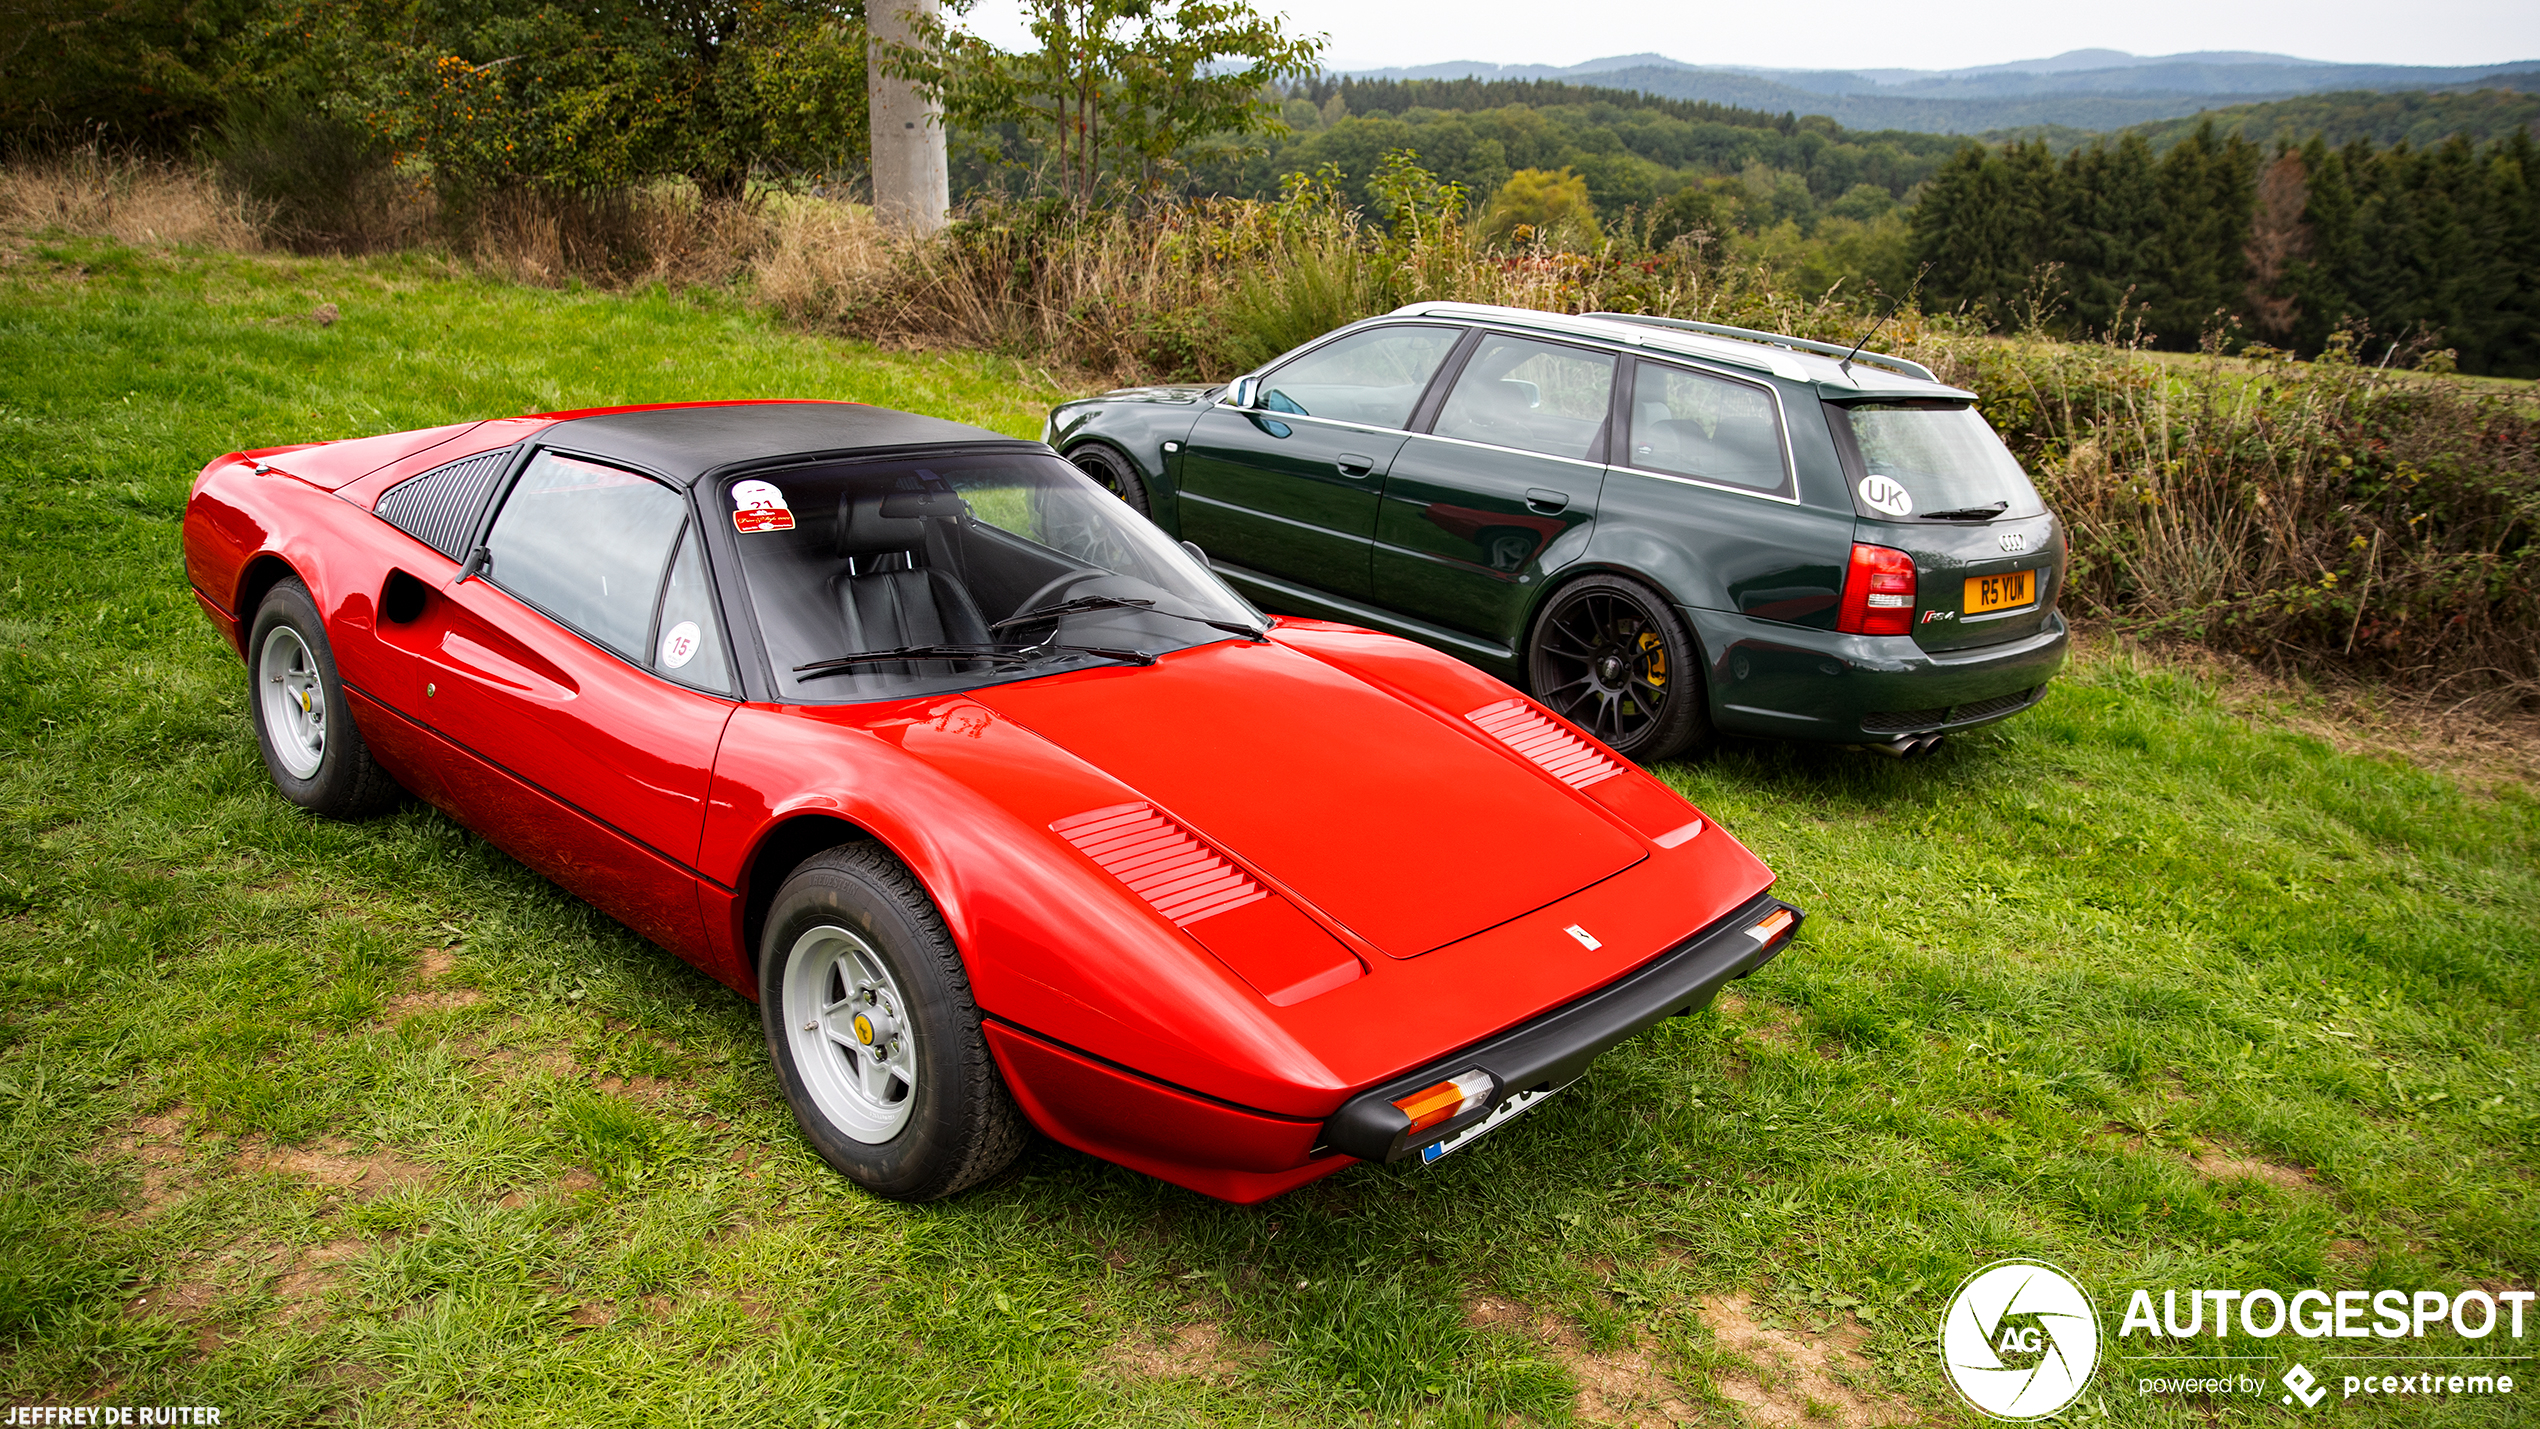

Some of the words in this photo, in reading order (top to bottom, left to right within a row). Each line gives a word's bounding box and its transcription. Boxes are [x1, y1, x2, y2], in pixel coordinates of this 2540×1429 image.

[1868, 479, 1904, 512] UK
[1981, 579, 1999, 606] R5
[2002, 574, 2025, 603] YUM
[672, 636, 691, 657] 15
